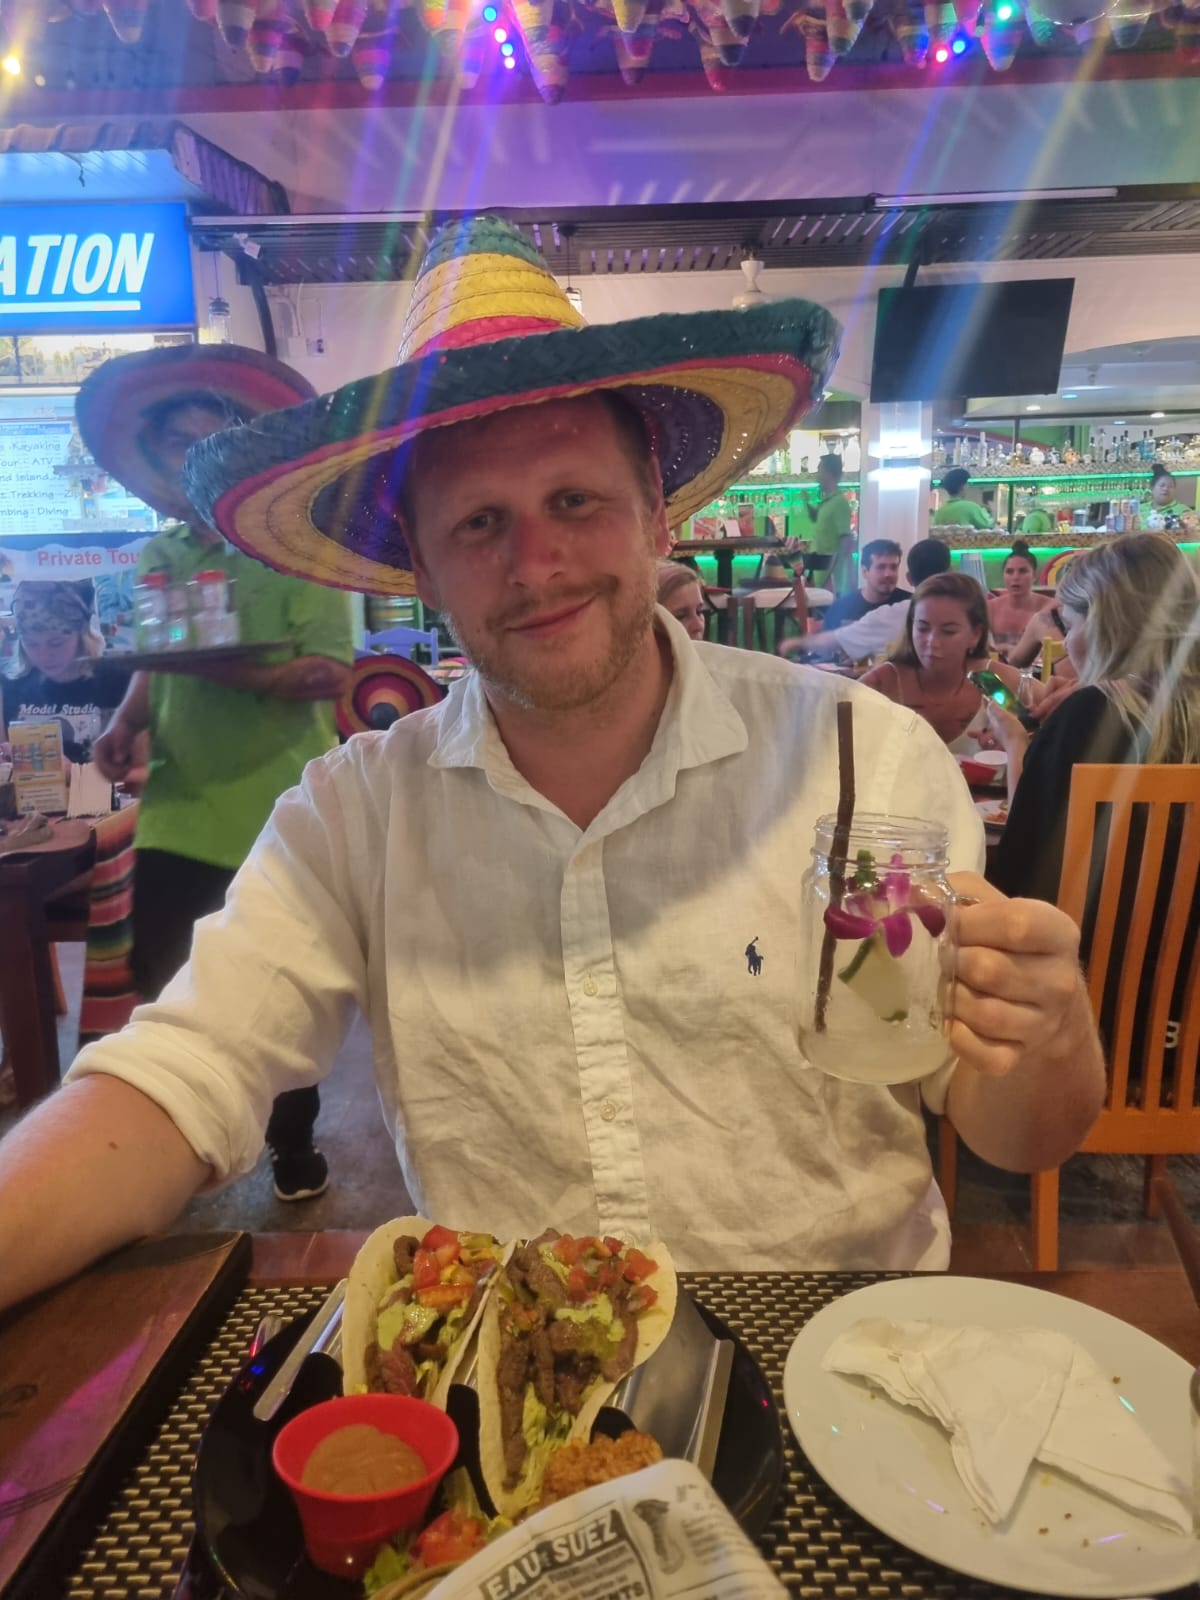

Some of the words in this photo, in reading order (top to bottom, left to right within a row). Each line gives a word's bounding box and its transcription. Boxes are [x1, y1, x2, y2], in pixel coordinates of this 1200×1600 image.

[37, 551, 102, 567] Private
[486, 1551, 542, 1600] EAU
[552, 1515, 618, 1563] SUEZ
